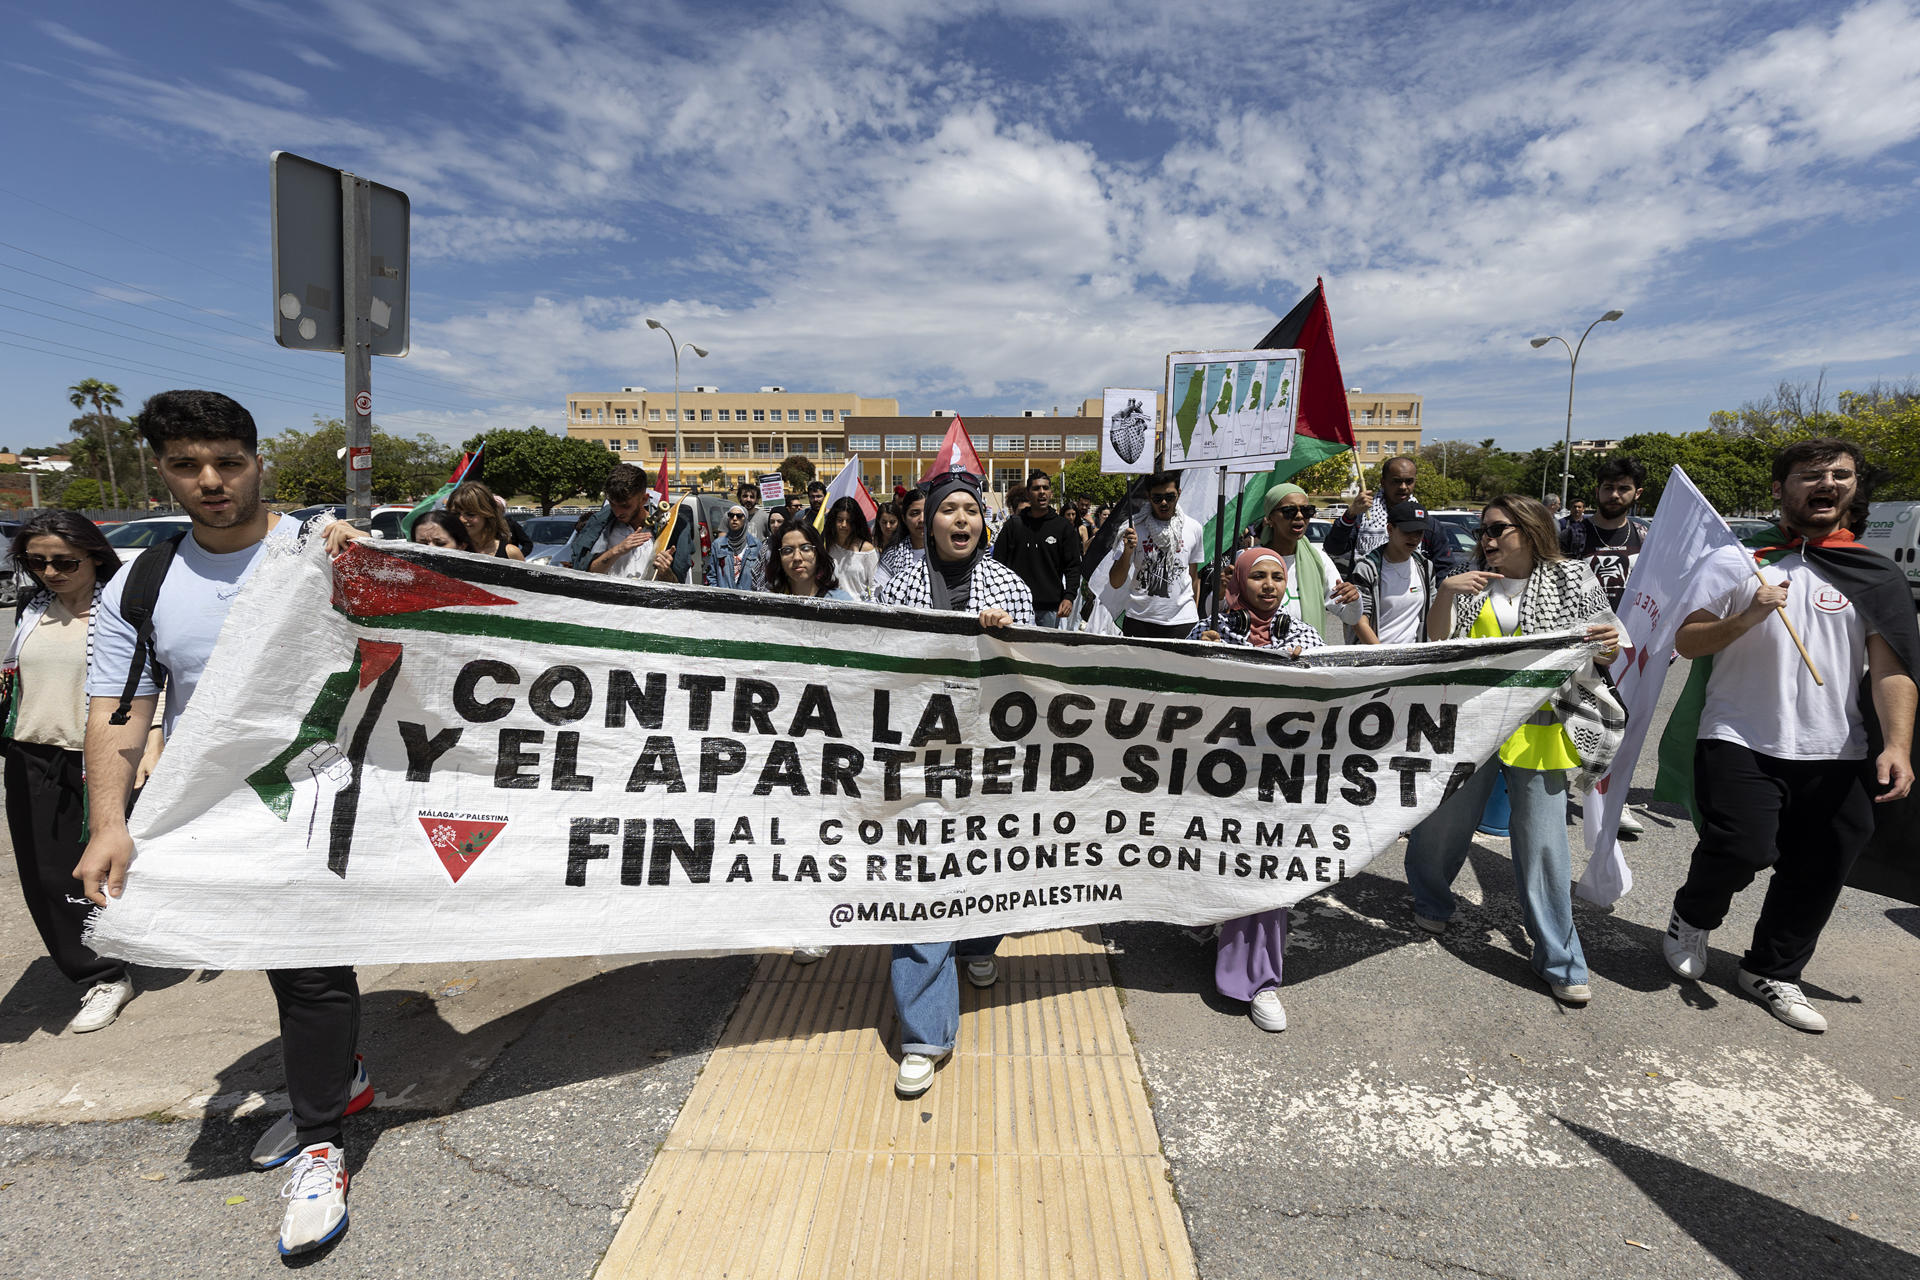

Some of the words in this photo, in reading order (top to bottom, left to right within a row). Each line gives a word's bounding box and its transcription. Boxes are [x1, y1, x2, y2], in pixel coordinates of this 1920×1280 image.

[453, 659, 843, 739] CONTRA
[872, 688, 962, 748] LA
[988, 687, 1458, 756] OCUPACIÓN
[398, 720, 464, 783] Y
[494, 728, 594, 792] EL
[625, 735, 1095, 802] APARTHEID
[418, 809, 454, 819] MÁLAGA
[466, 813, 509, 822] PALESTINA
[729, 815, 786, 846] AL
[819, 811, 1076, 847] COMERCIO
[1105, 809, 1157, 837] DE
[1183, 815, 1351, 851] ARMAS
[565, 817, 716, 888] FIN
[725, 853, 753, 883] A
[772, 853, 847, 883] LAS
[866, 842, 1103, 883] RELACIONES
[1118, 843, 1201, 872] CON
[1218, 851, 1350, 883] ISRAEL
[829, 883, 1123, 929] @MALAGAPORPALESTINA
